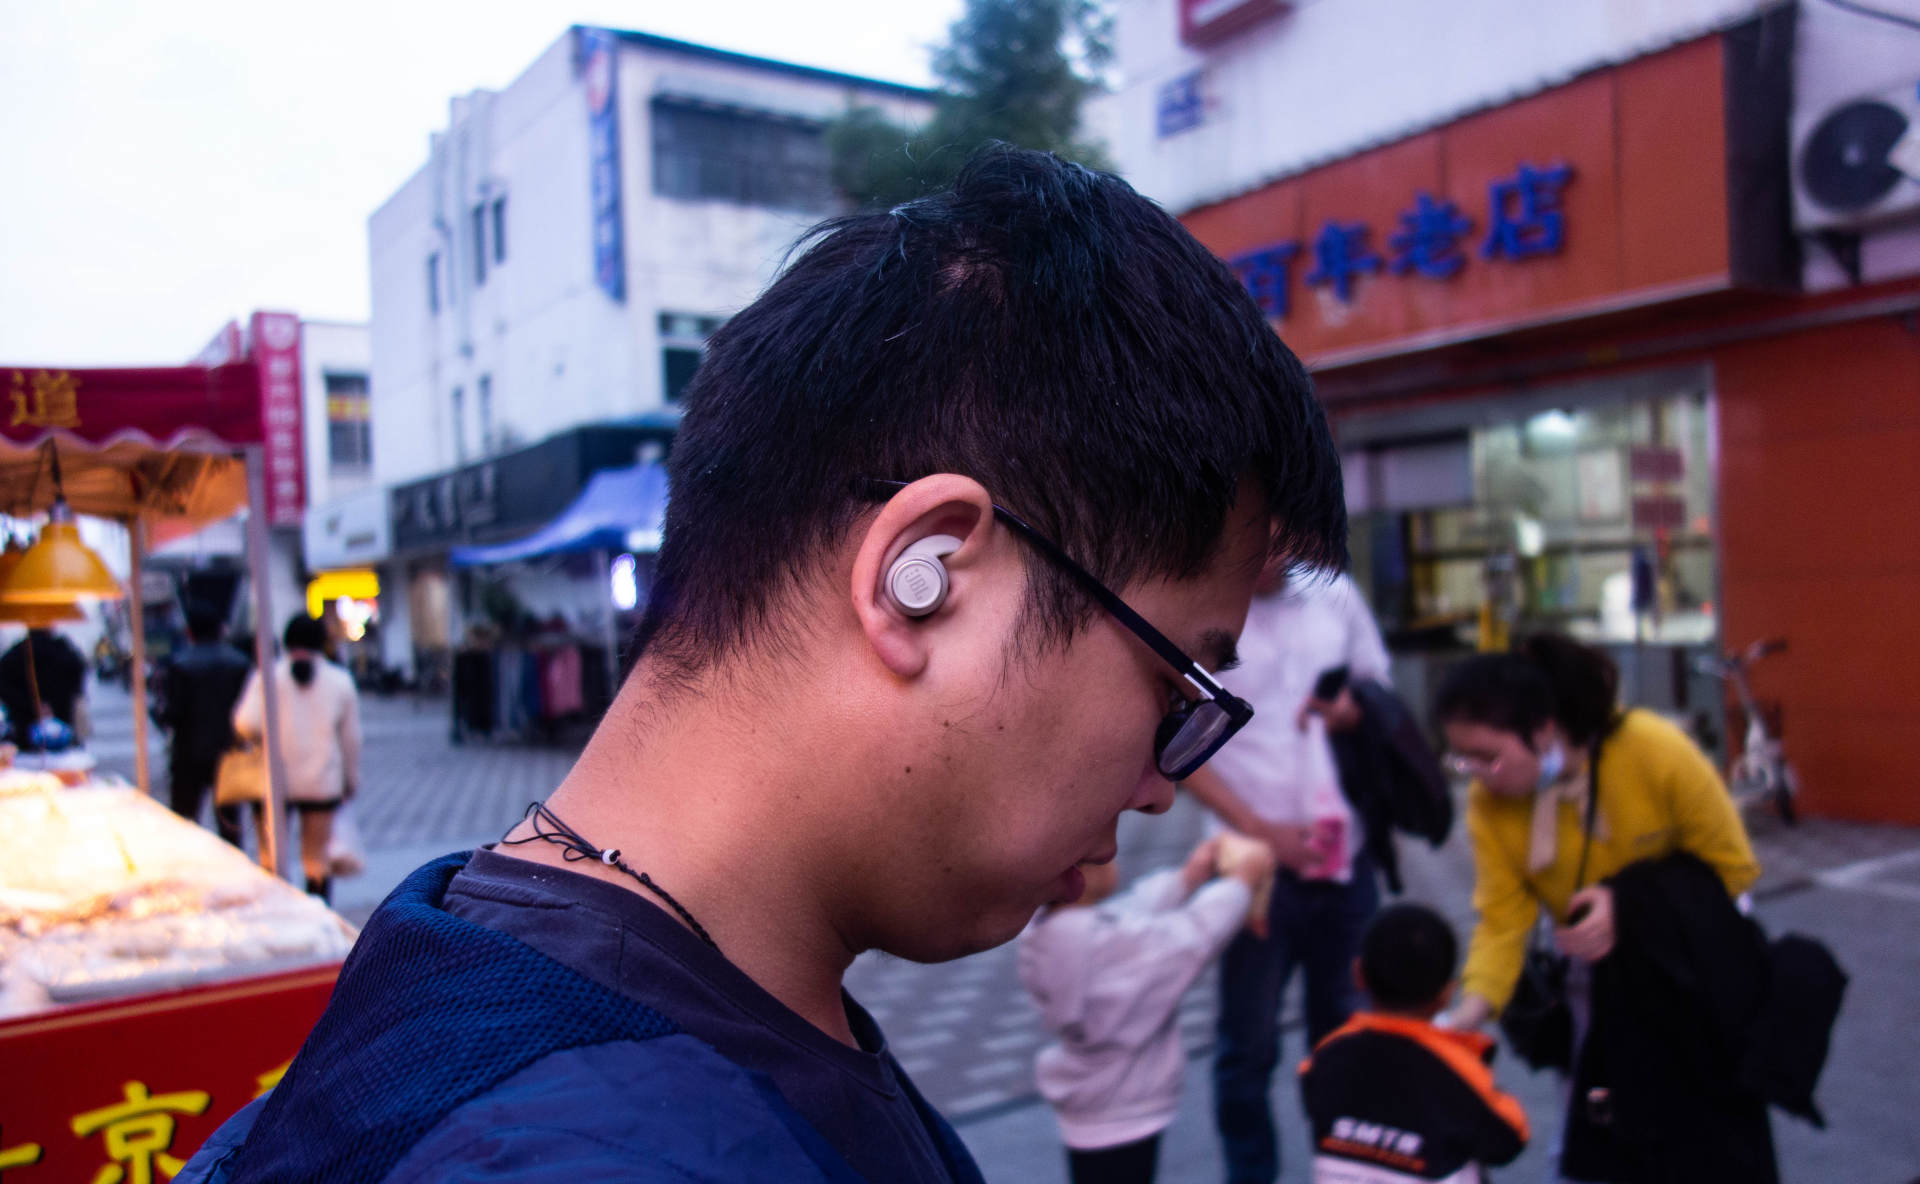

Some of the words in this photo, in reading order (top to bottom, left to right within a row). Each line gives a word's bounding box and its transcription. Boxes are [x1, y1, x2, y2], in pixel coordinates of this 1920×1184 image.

[1232, 162, 1573, 320] 百年老店
[904, 568, 929, 601] JBL
